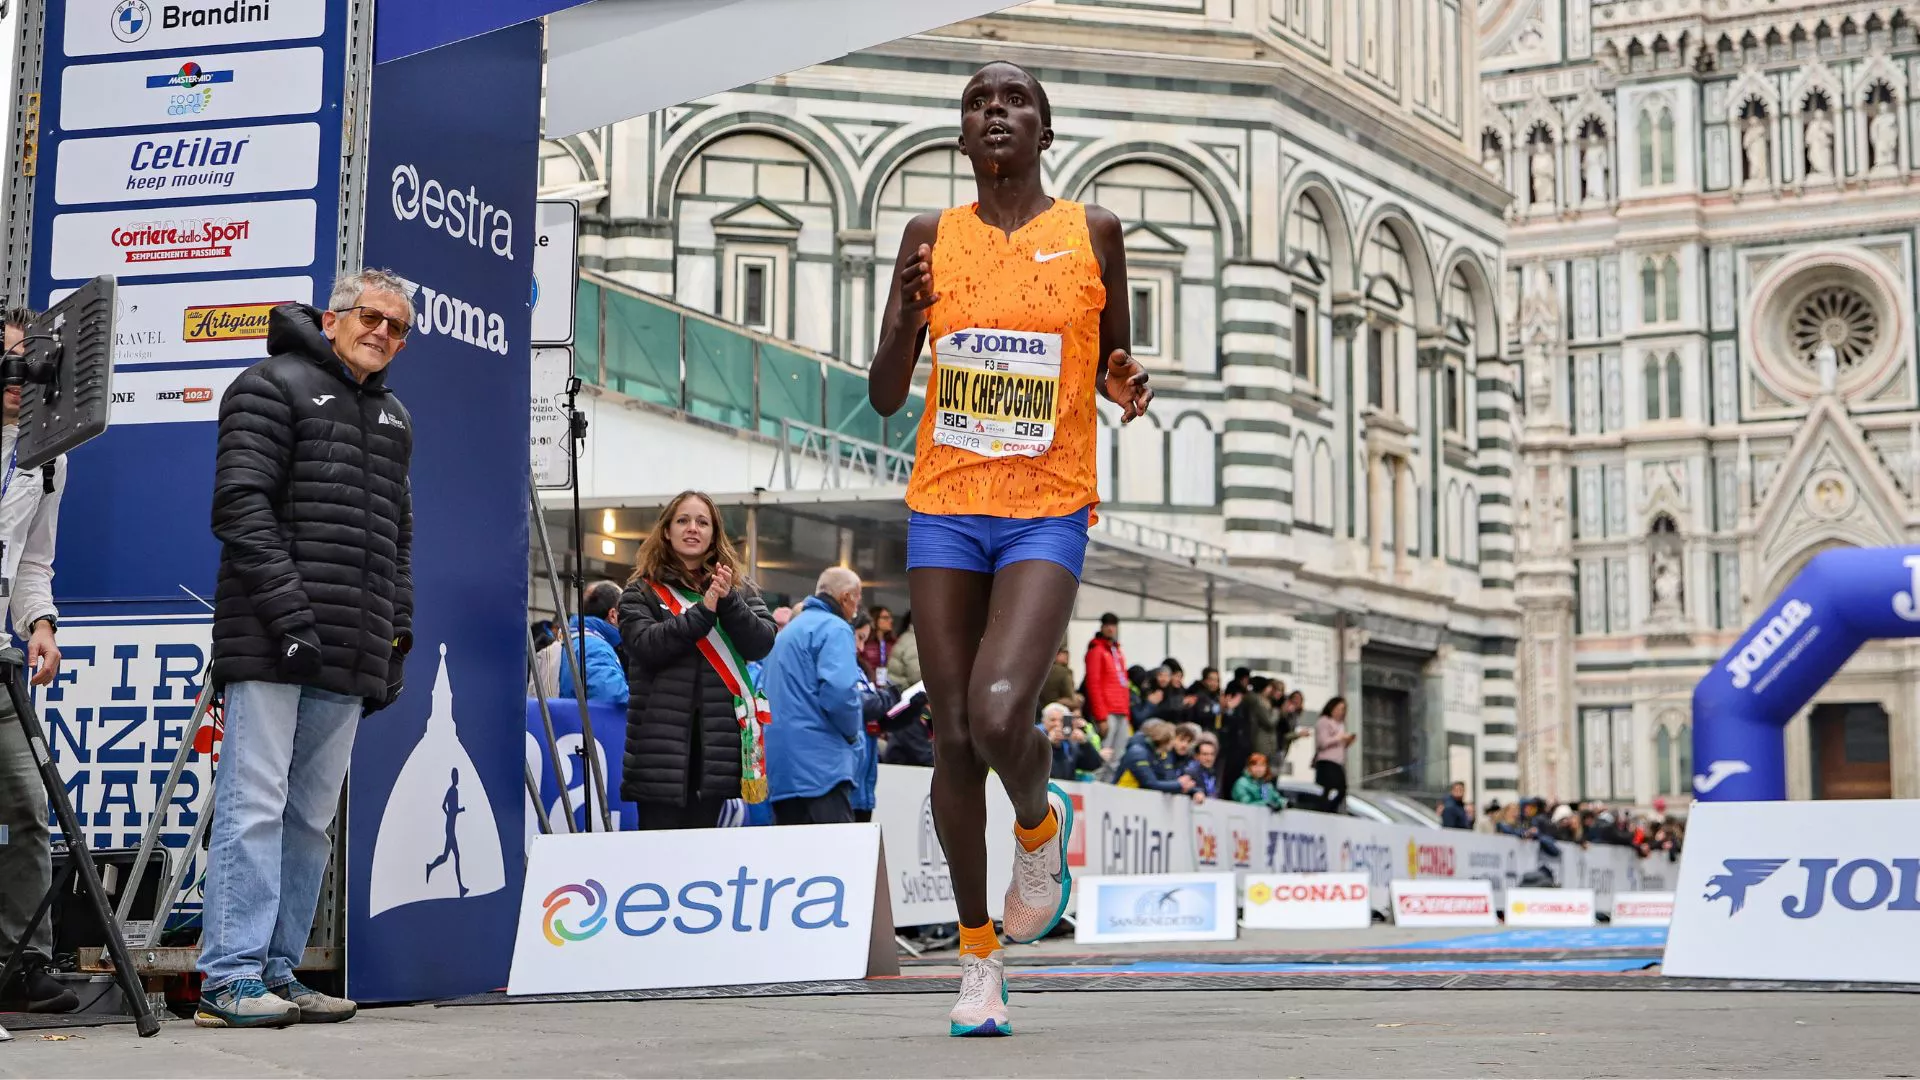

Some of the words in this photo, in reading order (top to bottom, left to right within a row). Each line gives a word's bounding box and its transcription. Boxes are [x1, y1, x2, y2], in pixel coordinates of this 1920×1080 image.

[117, 1, 146, 13] BMW
[162, 0, 269, 28] Brandini
[130, 136, 250, 171] Cetilar
[126, 174, 167, 190] keep
[171, 170, 235, 187] moving
[421, 179, 514, 260] estra
[111, 226, 177, 247] Corriere
[178, 229, 201, 244] dello
[202, 220, 250, 248] Sport
[132, 250, 189, 261] SEMPLICEMENTE
[191, 245, 226, 257] PASSIONE
[190, 309, 270, 337] Artigian
[115, 331, 166, 346] RAVEL
[984, 359, 995, 371] F3
[185, 390, 211, 400] 102.7
[938, 368, 969, 411] LUCY
[971, 373, 1055, 420] CHEPOGHON
[945, 430, 981, 449] estra
[46, 643, 205, 701] FIR
[48, 769, 200, 827] MAR
[614, 865, 849, 937] estra
[1274, 883, 1368, 902] CONAD
